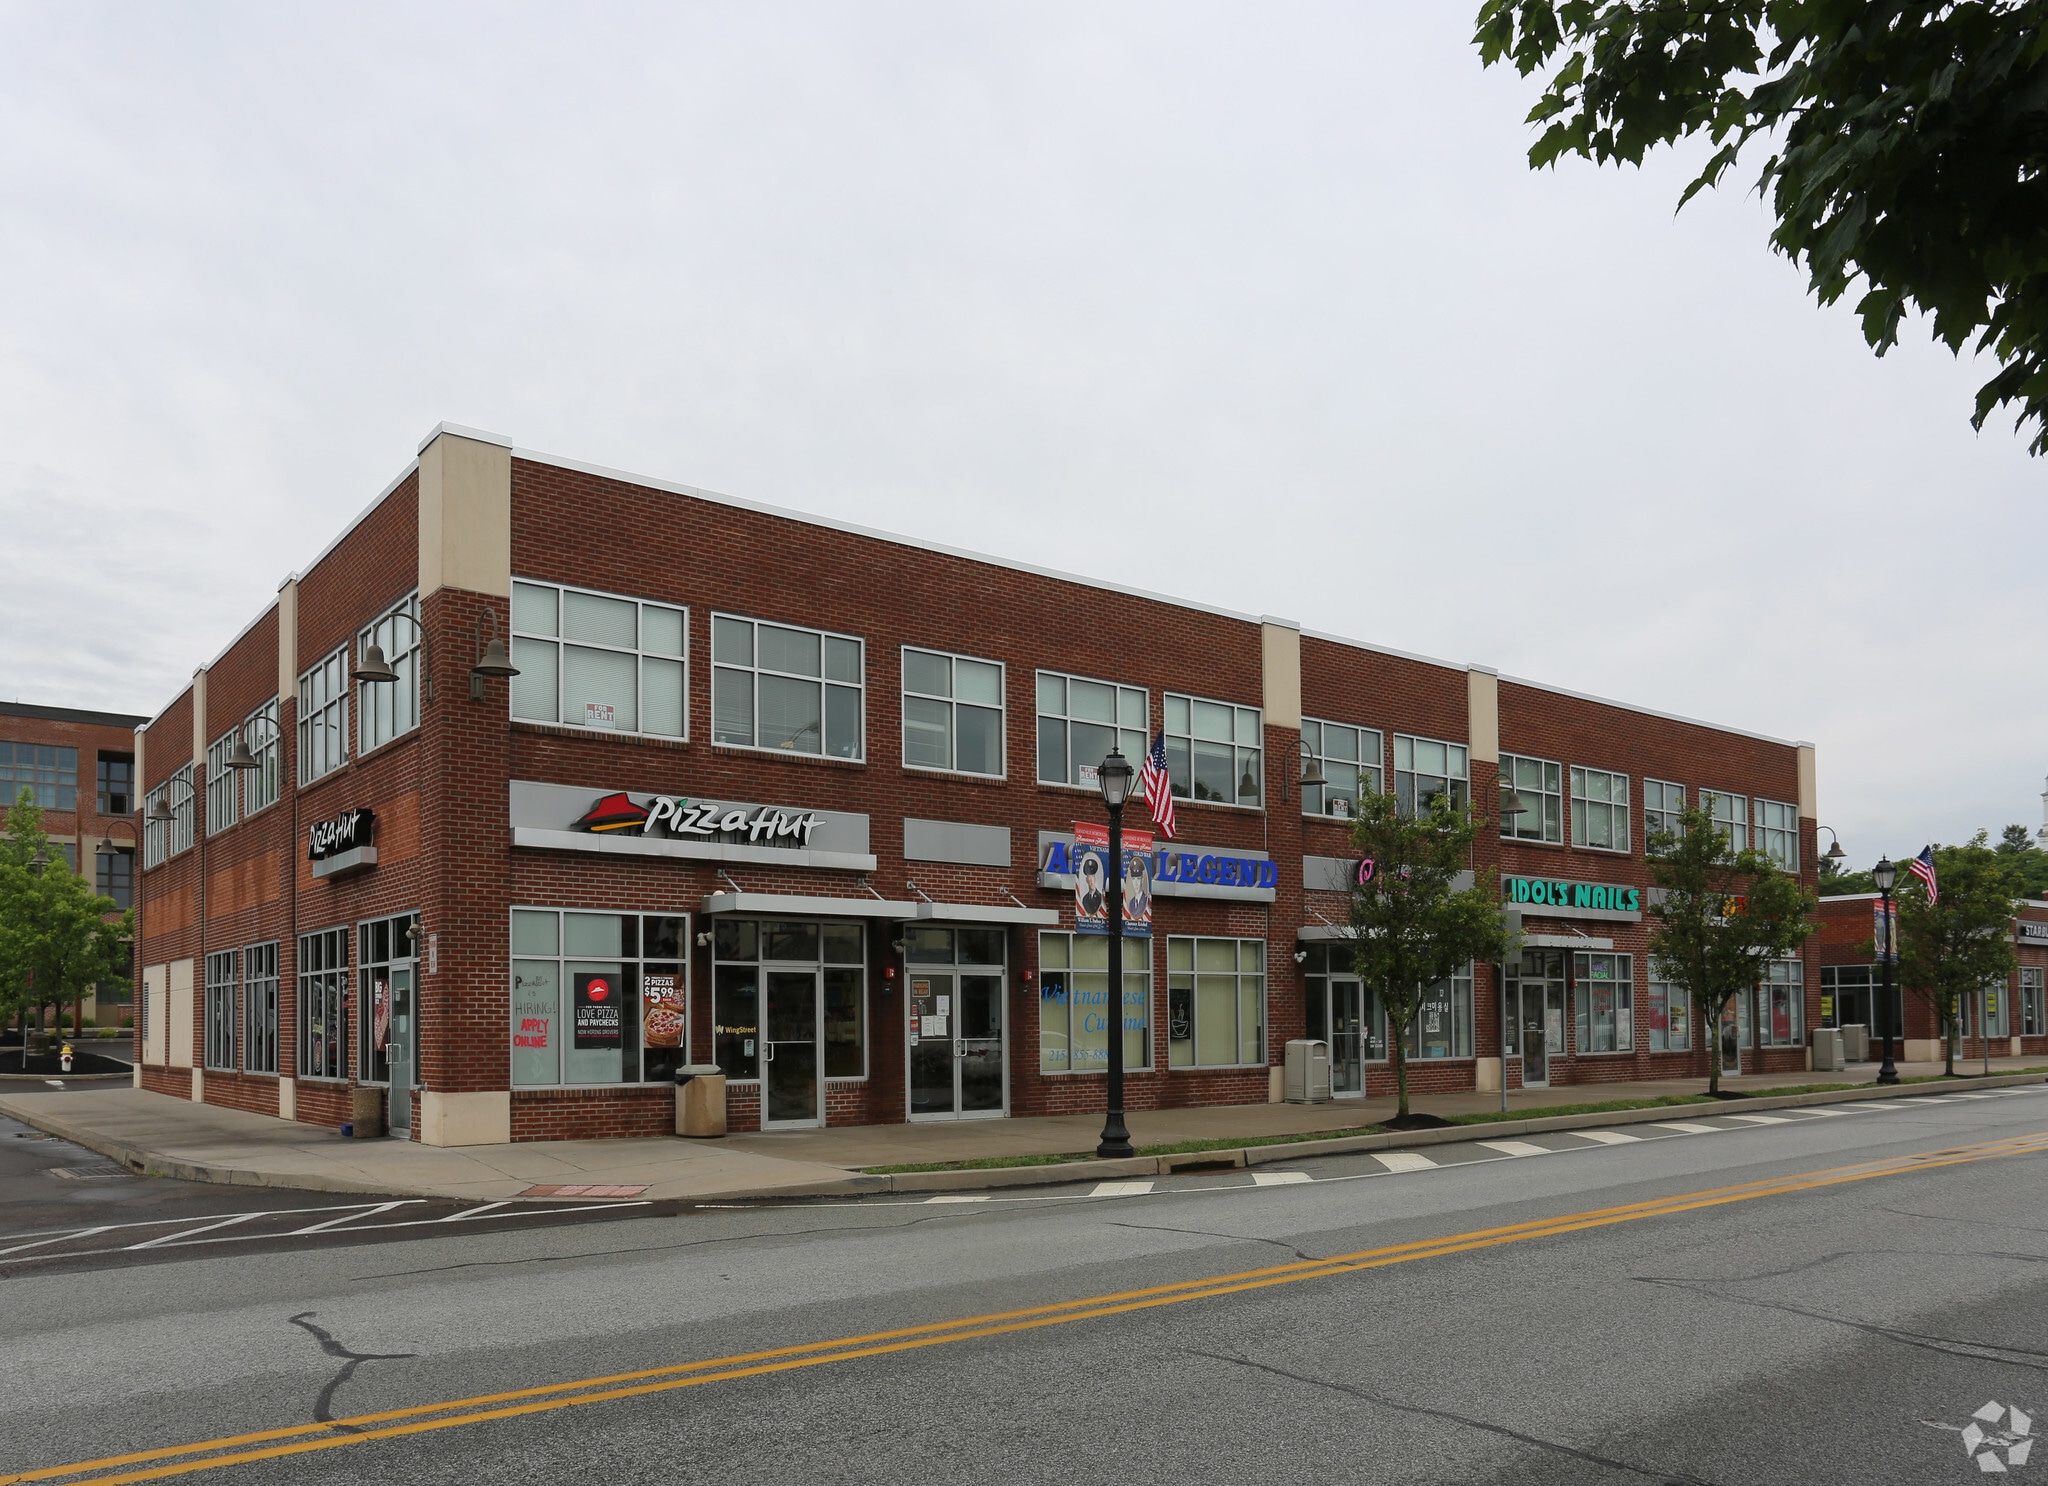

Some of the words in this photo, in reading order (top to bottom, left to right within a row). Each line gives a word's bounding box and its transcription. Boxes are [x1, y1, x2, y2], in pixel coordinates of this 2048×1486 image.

[588, 710, 614, 720] RENT
[644, 797, 748, 834] Pizza
[749, 806, 826, 846] Hut
[308, 821, 336, 859] Pizza
[335, 808, 360, 850] Hut
[1157, 851, 1278, 888] LEGEND
[1511, 878, 1568, 906] IDOL'S
[1575, 884, 1639, 911] NAILS
[645, 976, 650, 985] 2
[516, 1002, 556, 1016] HIRING!
[577, 1009, 595, 1018] LOVE
[598, 1009, 618, 1018] PIZZA
[521, 1018, 549, 1034] APPLY
[1084, 1012, 1146, 1033] Cuine
[725, 1026, 756, 1034] WingStreet
[513, 1034, 548, 1048] ONLINE
[1049, 1050, 1109, 1062] 215-855-888
